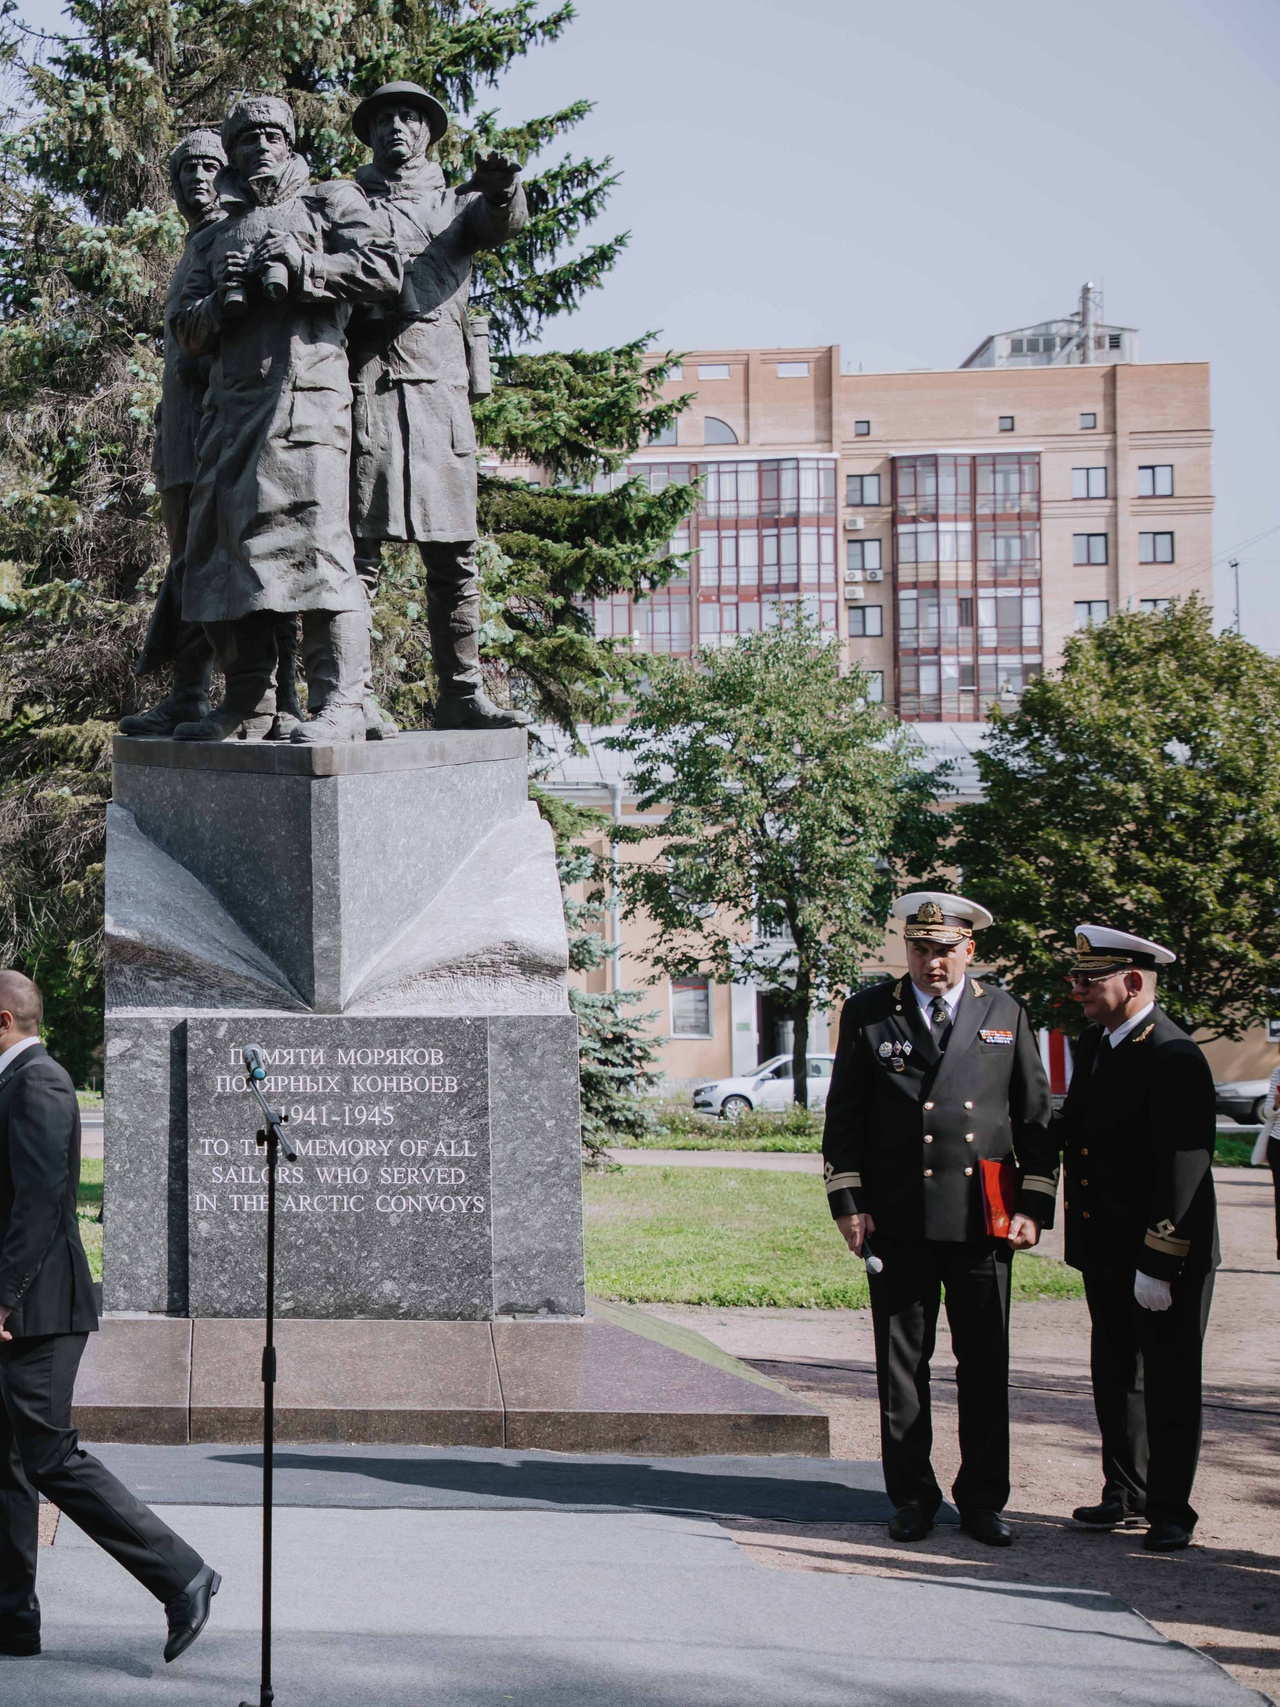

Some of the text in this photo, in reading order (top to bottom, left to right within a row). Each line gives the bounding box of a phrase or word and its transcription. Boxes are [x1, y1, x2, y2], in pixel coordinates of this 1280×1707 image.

[229, 1048, 444, 1066] ПМЯТИ МОРЯКОВ
[352, 1075, 458, 1093] КОНВОЕВ
[279, 1105, 394, 1126] 1941-1945
[200, 1139, 229, 1156] TO
[295, 1139, 394, 1156] MEMORY
[400, 1139, 429, 1156] OF
[433, 1140, 477, 1157] ALL
[317, 1167, 368, 1184] WHO
[380, 1167, 466, 1185] SERVED
[195, 1194, 485, 1213] IN THE ARCTIC CONVOYS
